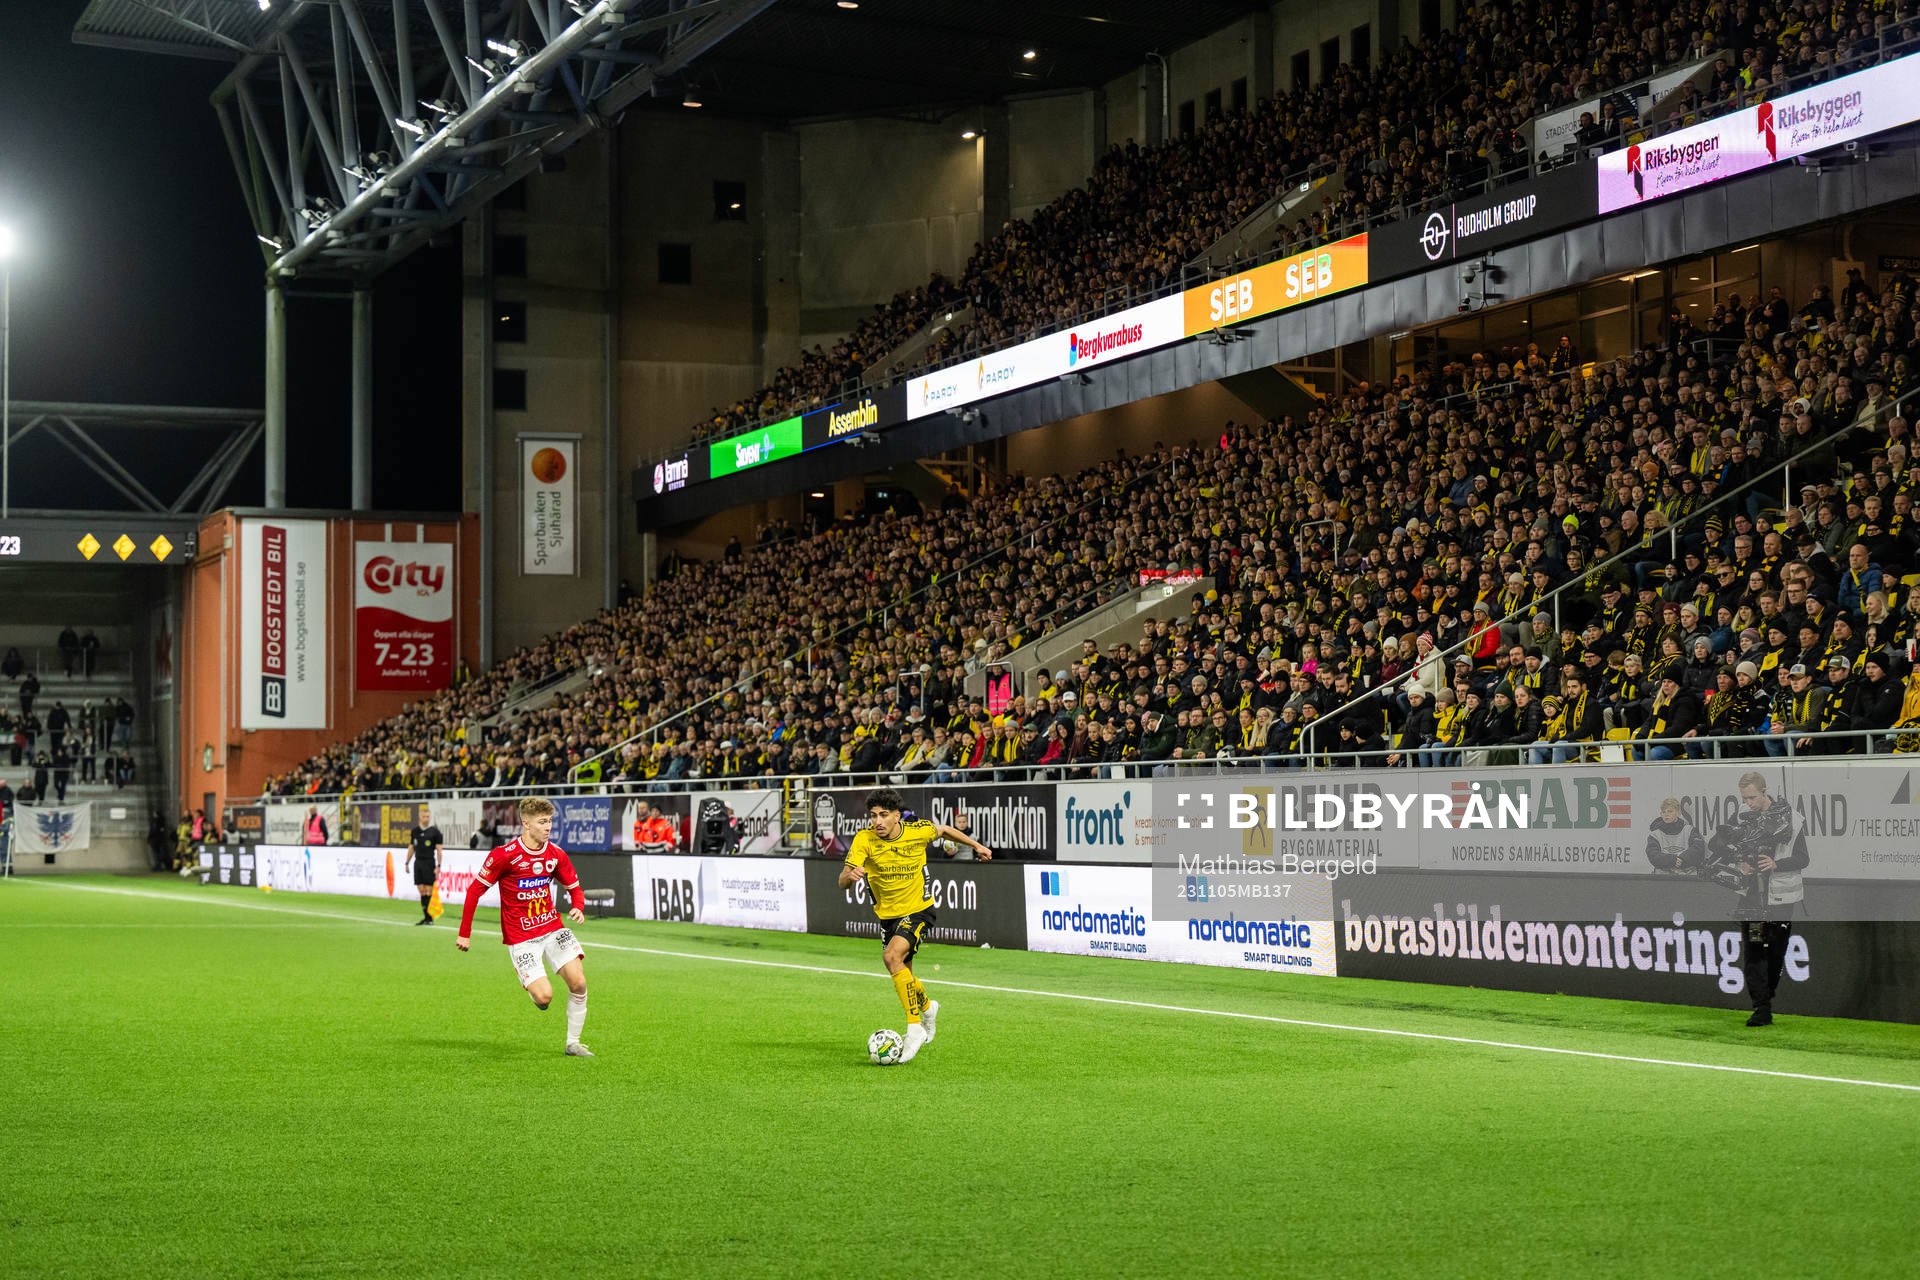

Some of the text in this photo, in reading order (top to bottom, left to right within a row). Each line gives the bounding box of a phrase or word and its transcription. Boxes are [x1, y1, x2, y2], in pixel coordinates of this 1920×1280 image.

[1779, 91, 1861, 129] Riksbyggen
[1645, 135, 1719, 170] Riksbyggen
[1457, 194, 1537, 239] RUDHOLM GROUP
[1285, 253, 1333, 298] SEB
[1210, 278, 1254, 321] SEB
[1078, 323, 1142, 360] Bergkvarabuss
[828, 398, 878, 438] Assemblin
[534, 490, 548, 566] Sparbanken
[549, 490, 564, 548] Sjuhärad
[0, 536, 21, 555] 23
[266, 532, 282, 563] BIL
[266, 567, 282, 669] BOGSTEDT
[373, 629, 397, 639] Öppet
[398, 629, 412, 639] alla
[373, 642, 434, 667] 7-23
[1065, 796, 1125, 846] front
[1680, 793, 1848, 838] SIMOAND
[1859, 819, 1881, 837] THE
[1885, 819, 1920, 837] CREAT
[1141, 834, 1160, 846] smart
[1281, 839, 1383, 857] BYGGMATERIAL
[1452, 843, 1631, 863] NORDENS SAMHÄLLSBYGGARE
[1861, 850, 1872, 863] Ett
[651, 877, 695, 923] IBAB
[1042, 904, 1146, 937] nordomatic
[1188, 911, 1311, 949] nordomatic
[1090, 940, 1147, 954] SMART BUILDINGS
[1244, 951, 1312, 968] SMART BUILDINGS
[1342, 899, 1810, 994] borasbildemonteringe
